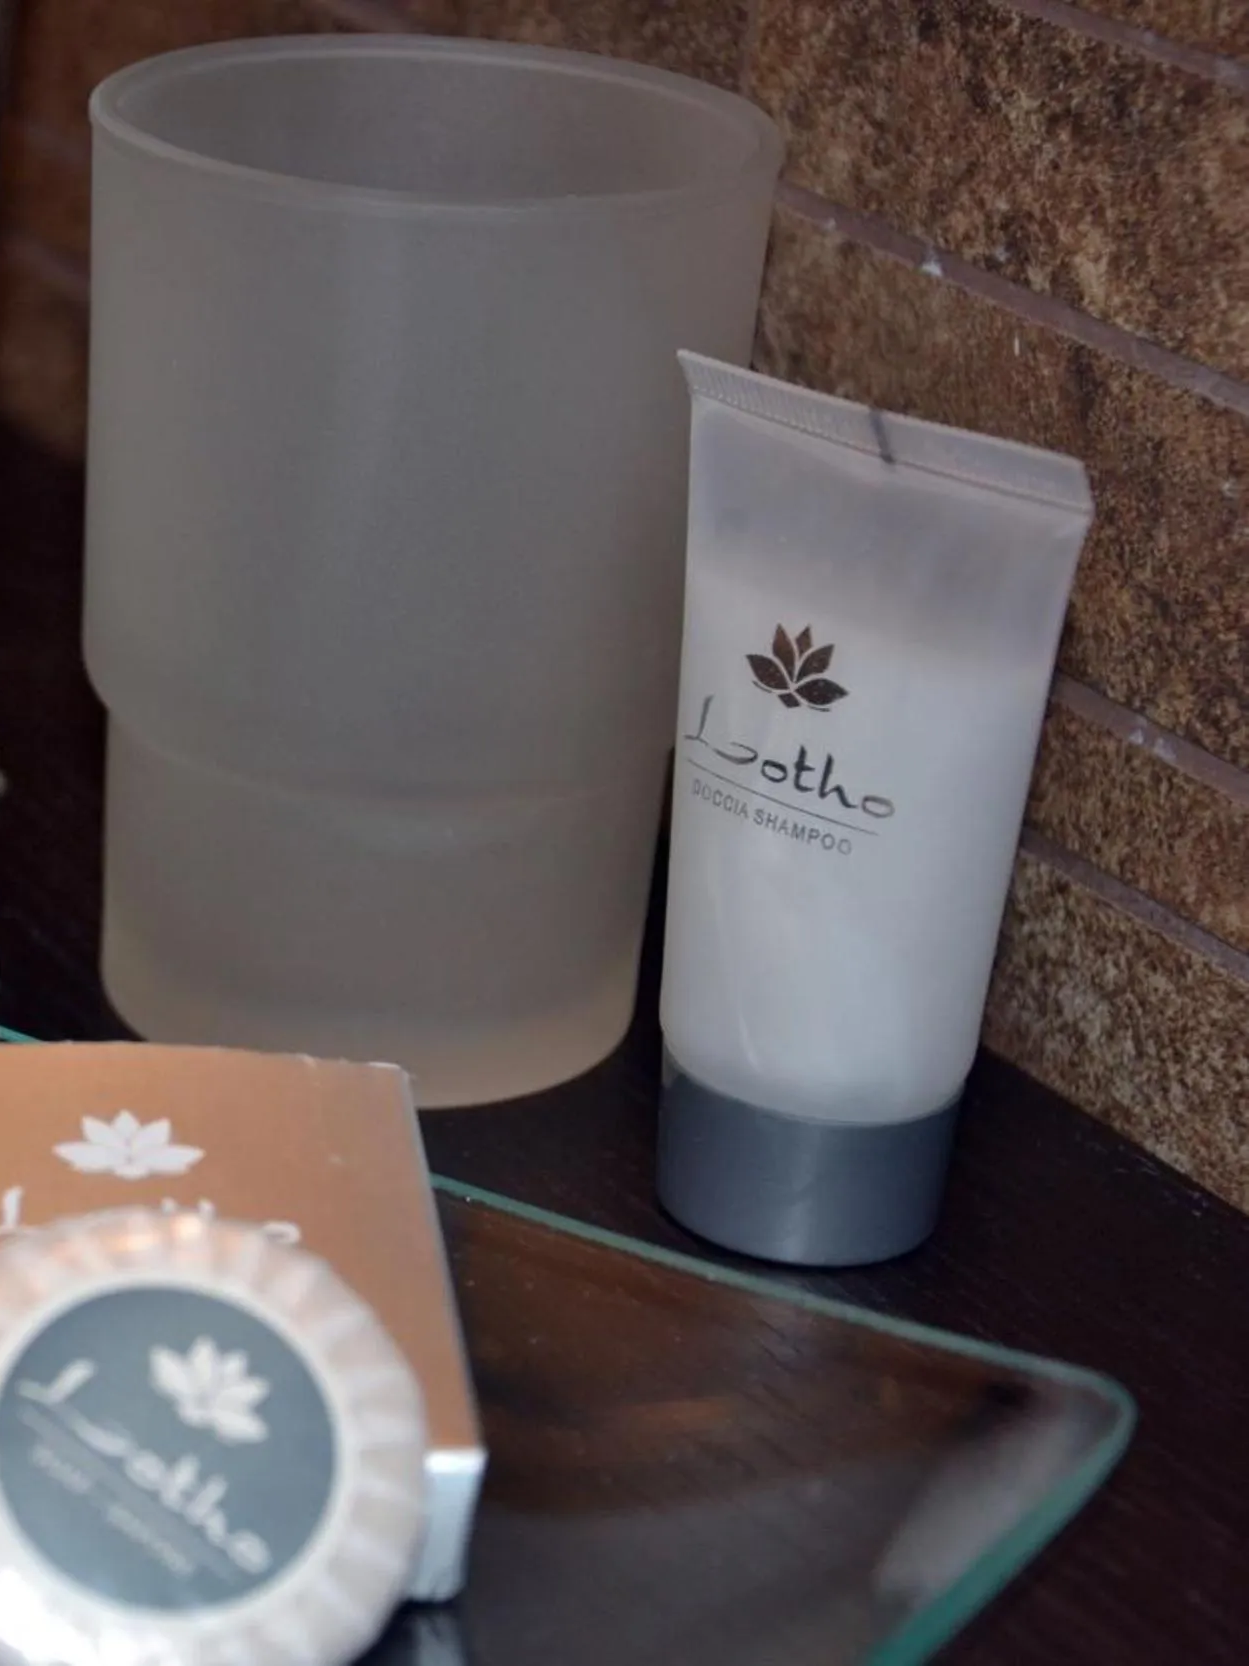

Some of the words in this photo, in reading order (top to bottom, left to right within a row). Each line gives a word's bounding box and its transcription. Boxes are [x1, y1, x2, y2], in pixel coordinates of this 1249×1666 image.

[684, 694, 896, 820] Lotho
[692, 778, 749, 820] DOCCIA
[753, 808, 853, 857] SHAMPOO
